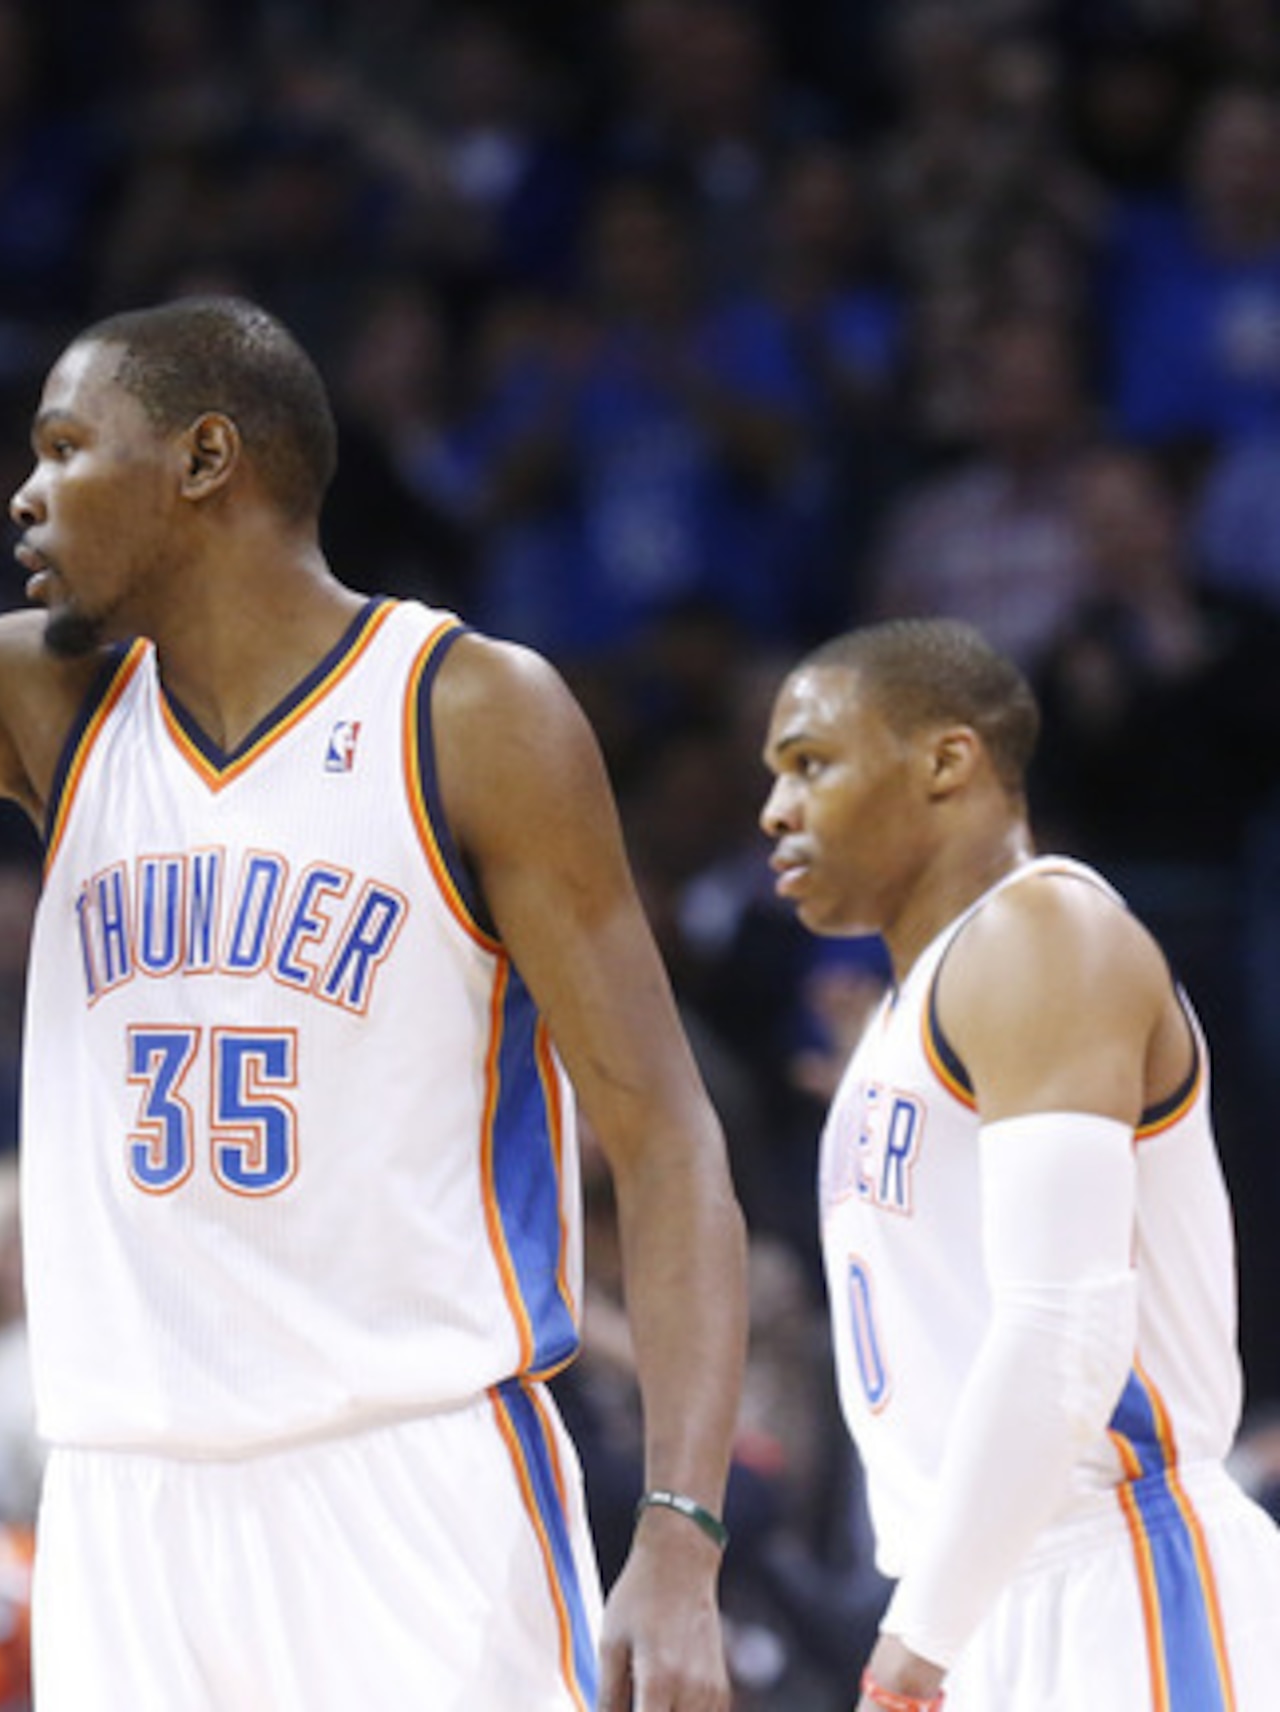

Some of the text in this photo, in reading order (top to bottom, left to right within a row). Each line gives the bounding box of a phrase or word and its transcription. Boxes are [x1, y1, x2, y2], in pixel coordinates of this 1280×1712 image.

[74, 846, 410, 1017] THUNDER
[126, 1023, 299, 1198] 35
[847, 1252, 891, 1417] 0
